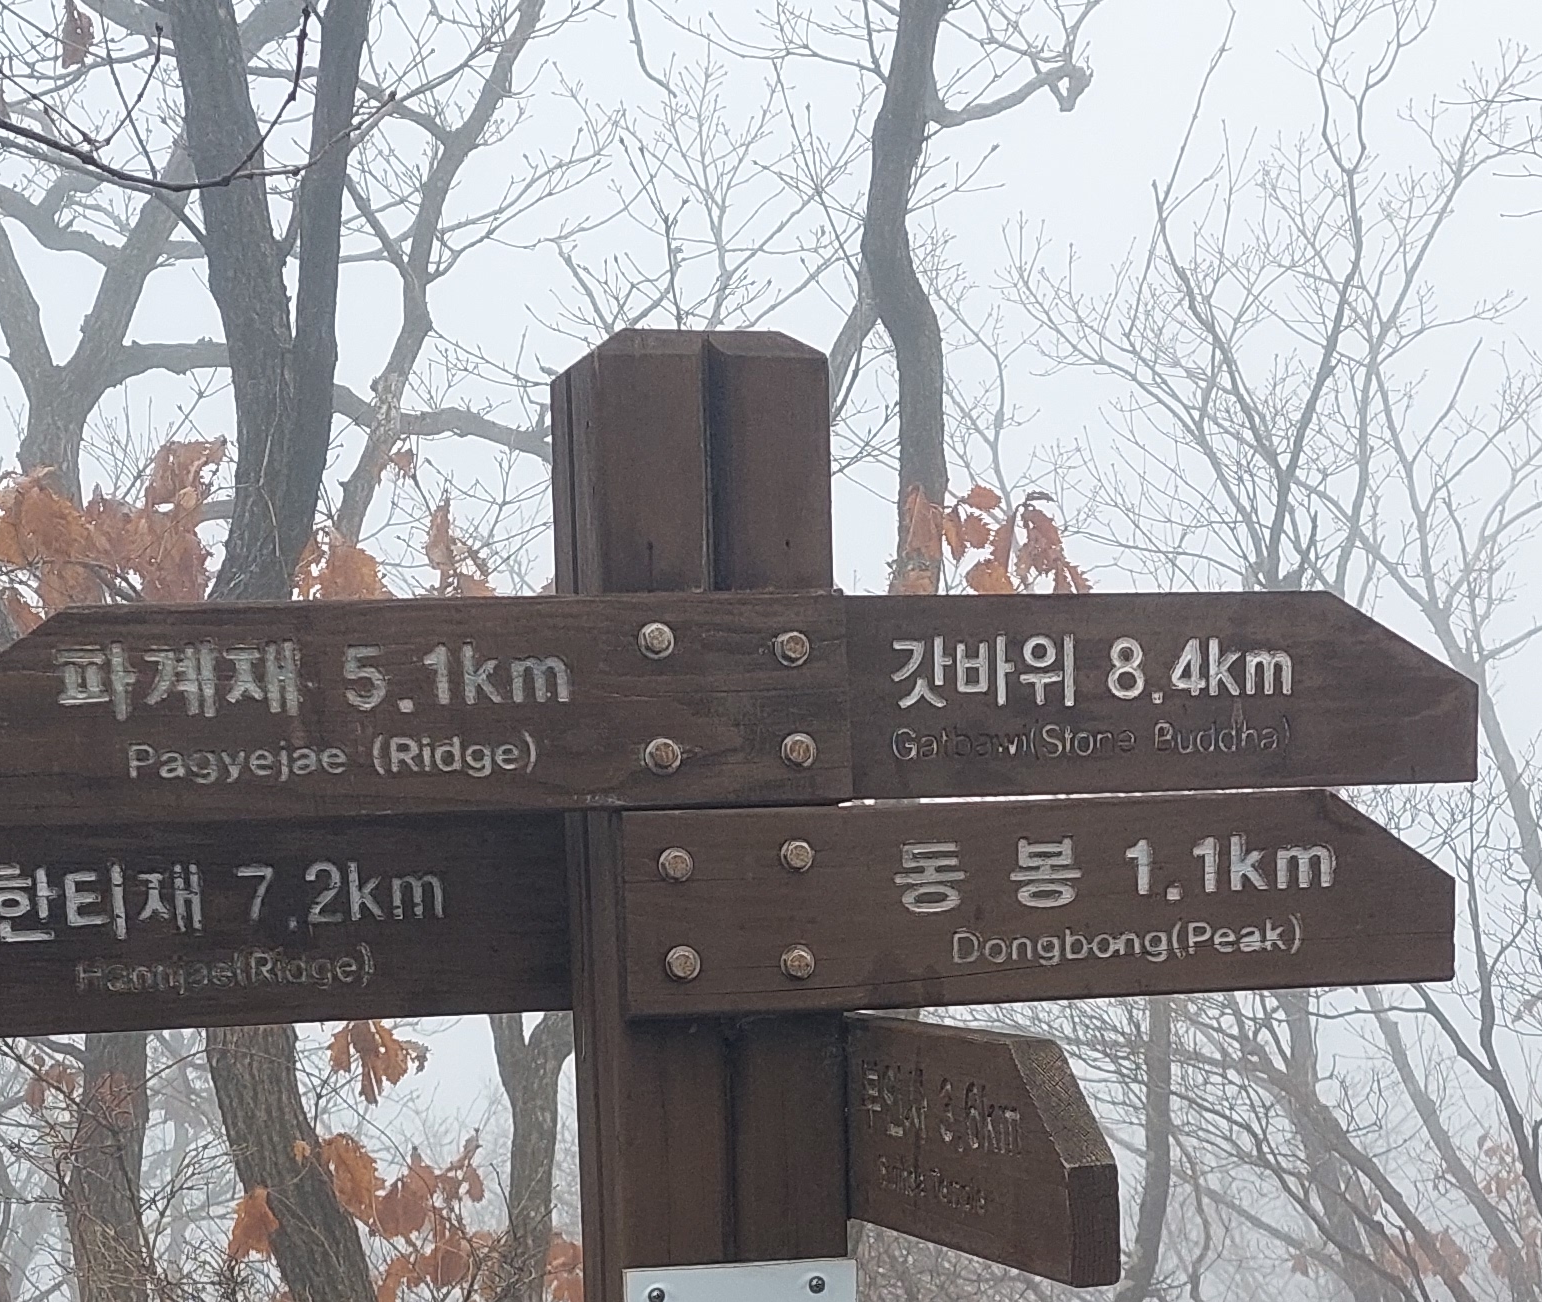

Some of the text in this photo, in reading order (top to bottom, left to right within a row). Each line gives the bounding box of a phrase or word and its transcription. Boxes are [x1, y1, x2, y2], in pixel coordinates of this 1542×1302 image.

[55, 639, 572, 722] 파계재 5.1km
[889, 632, 1293, 709] 갓바위 8.4km
[128, 732, 538, 784] Pagyejae (Ridge)
[1154, 716, 1293, 756] Buddha)
[235, 861, 444, 931] 7.2km
[1126, 833, 1336, 902] 1.1km
